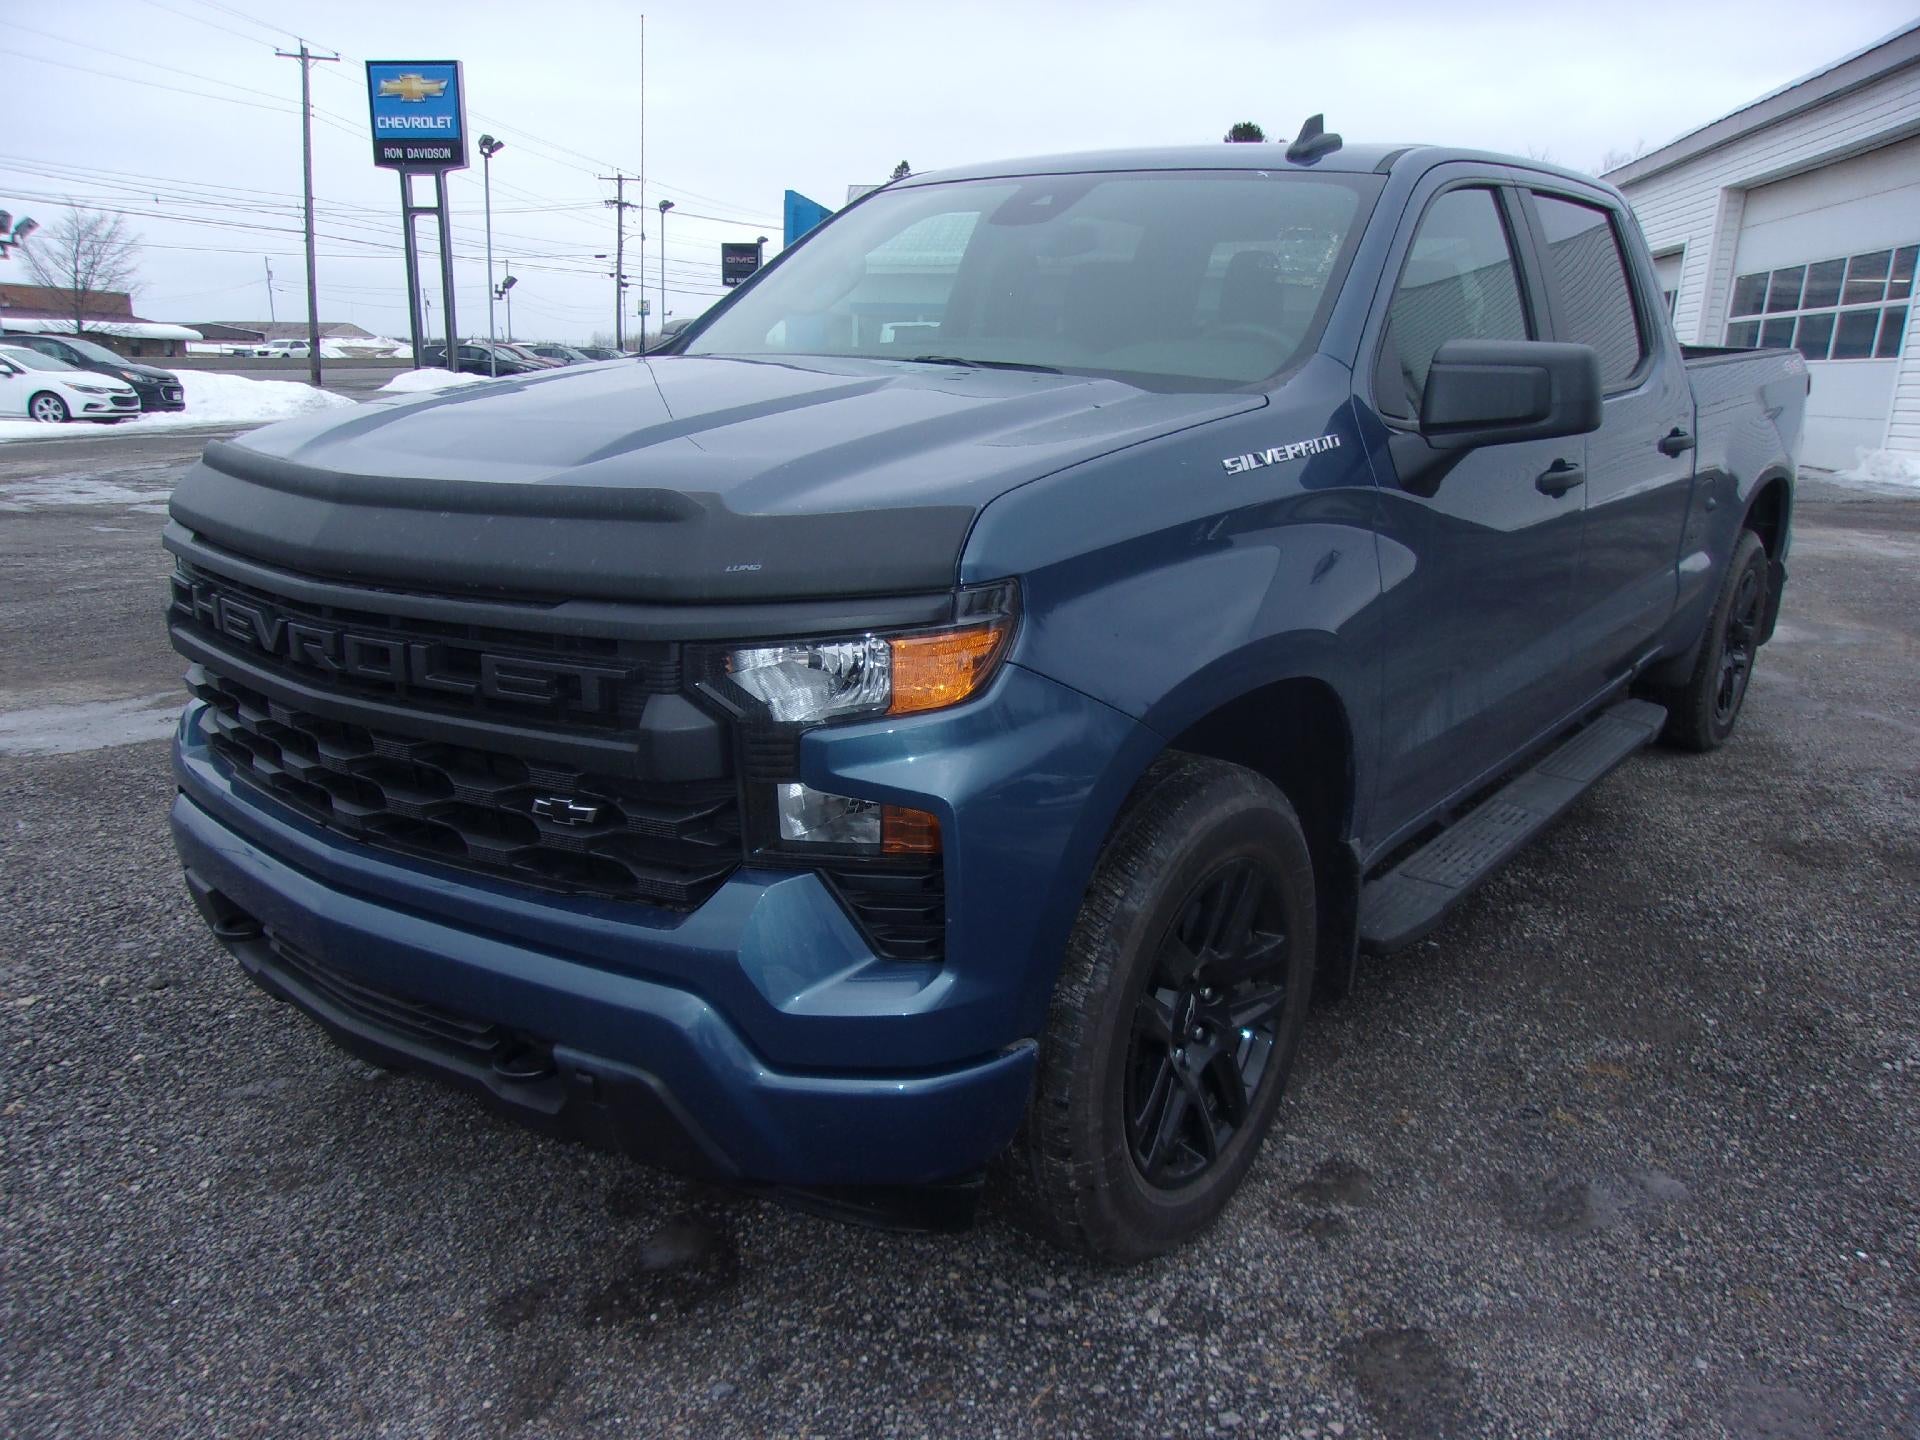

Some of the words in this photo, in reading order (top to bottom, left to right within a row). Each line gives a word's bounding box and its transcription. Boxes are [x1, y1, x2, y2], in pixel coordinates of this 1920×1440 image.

[377, 116, 452, 128] CHEVROLET
[384, 148, 402, 158] RON
[407, 148, 451, 158] DAVIDSON
[726, 256, 756, 264] GMC
[1223, 434, 1340, 475] SILVERADO
[171, 570, 632, 711] CHEVROLET
